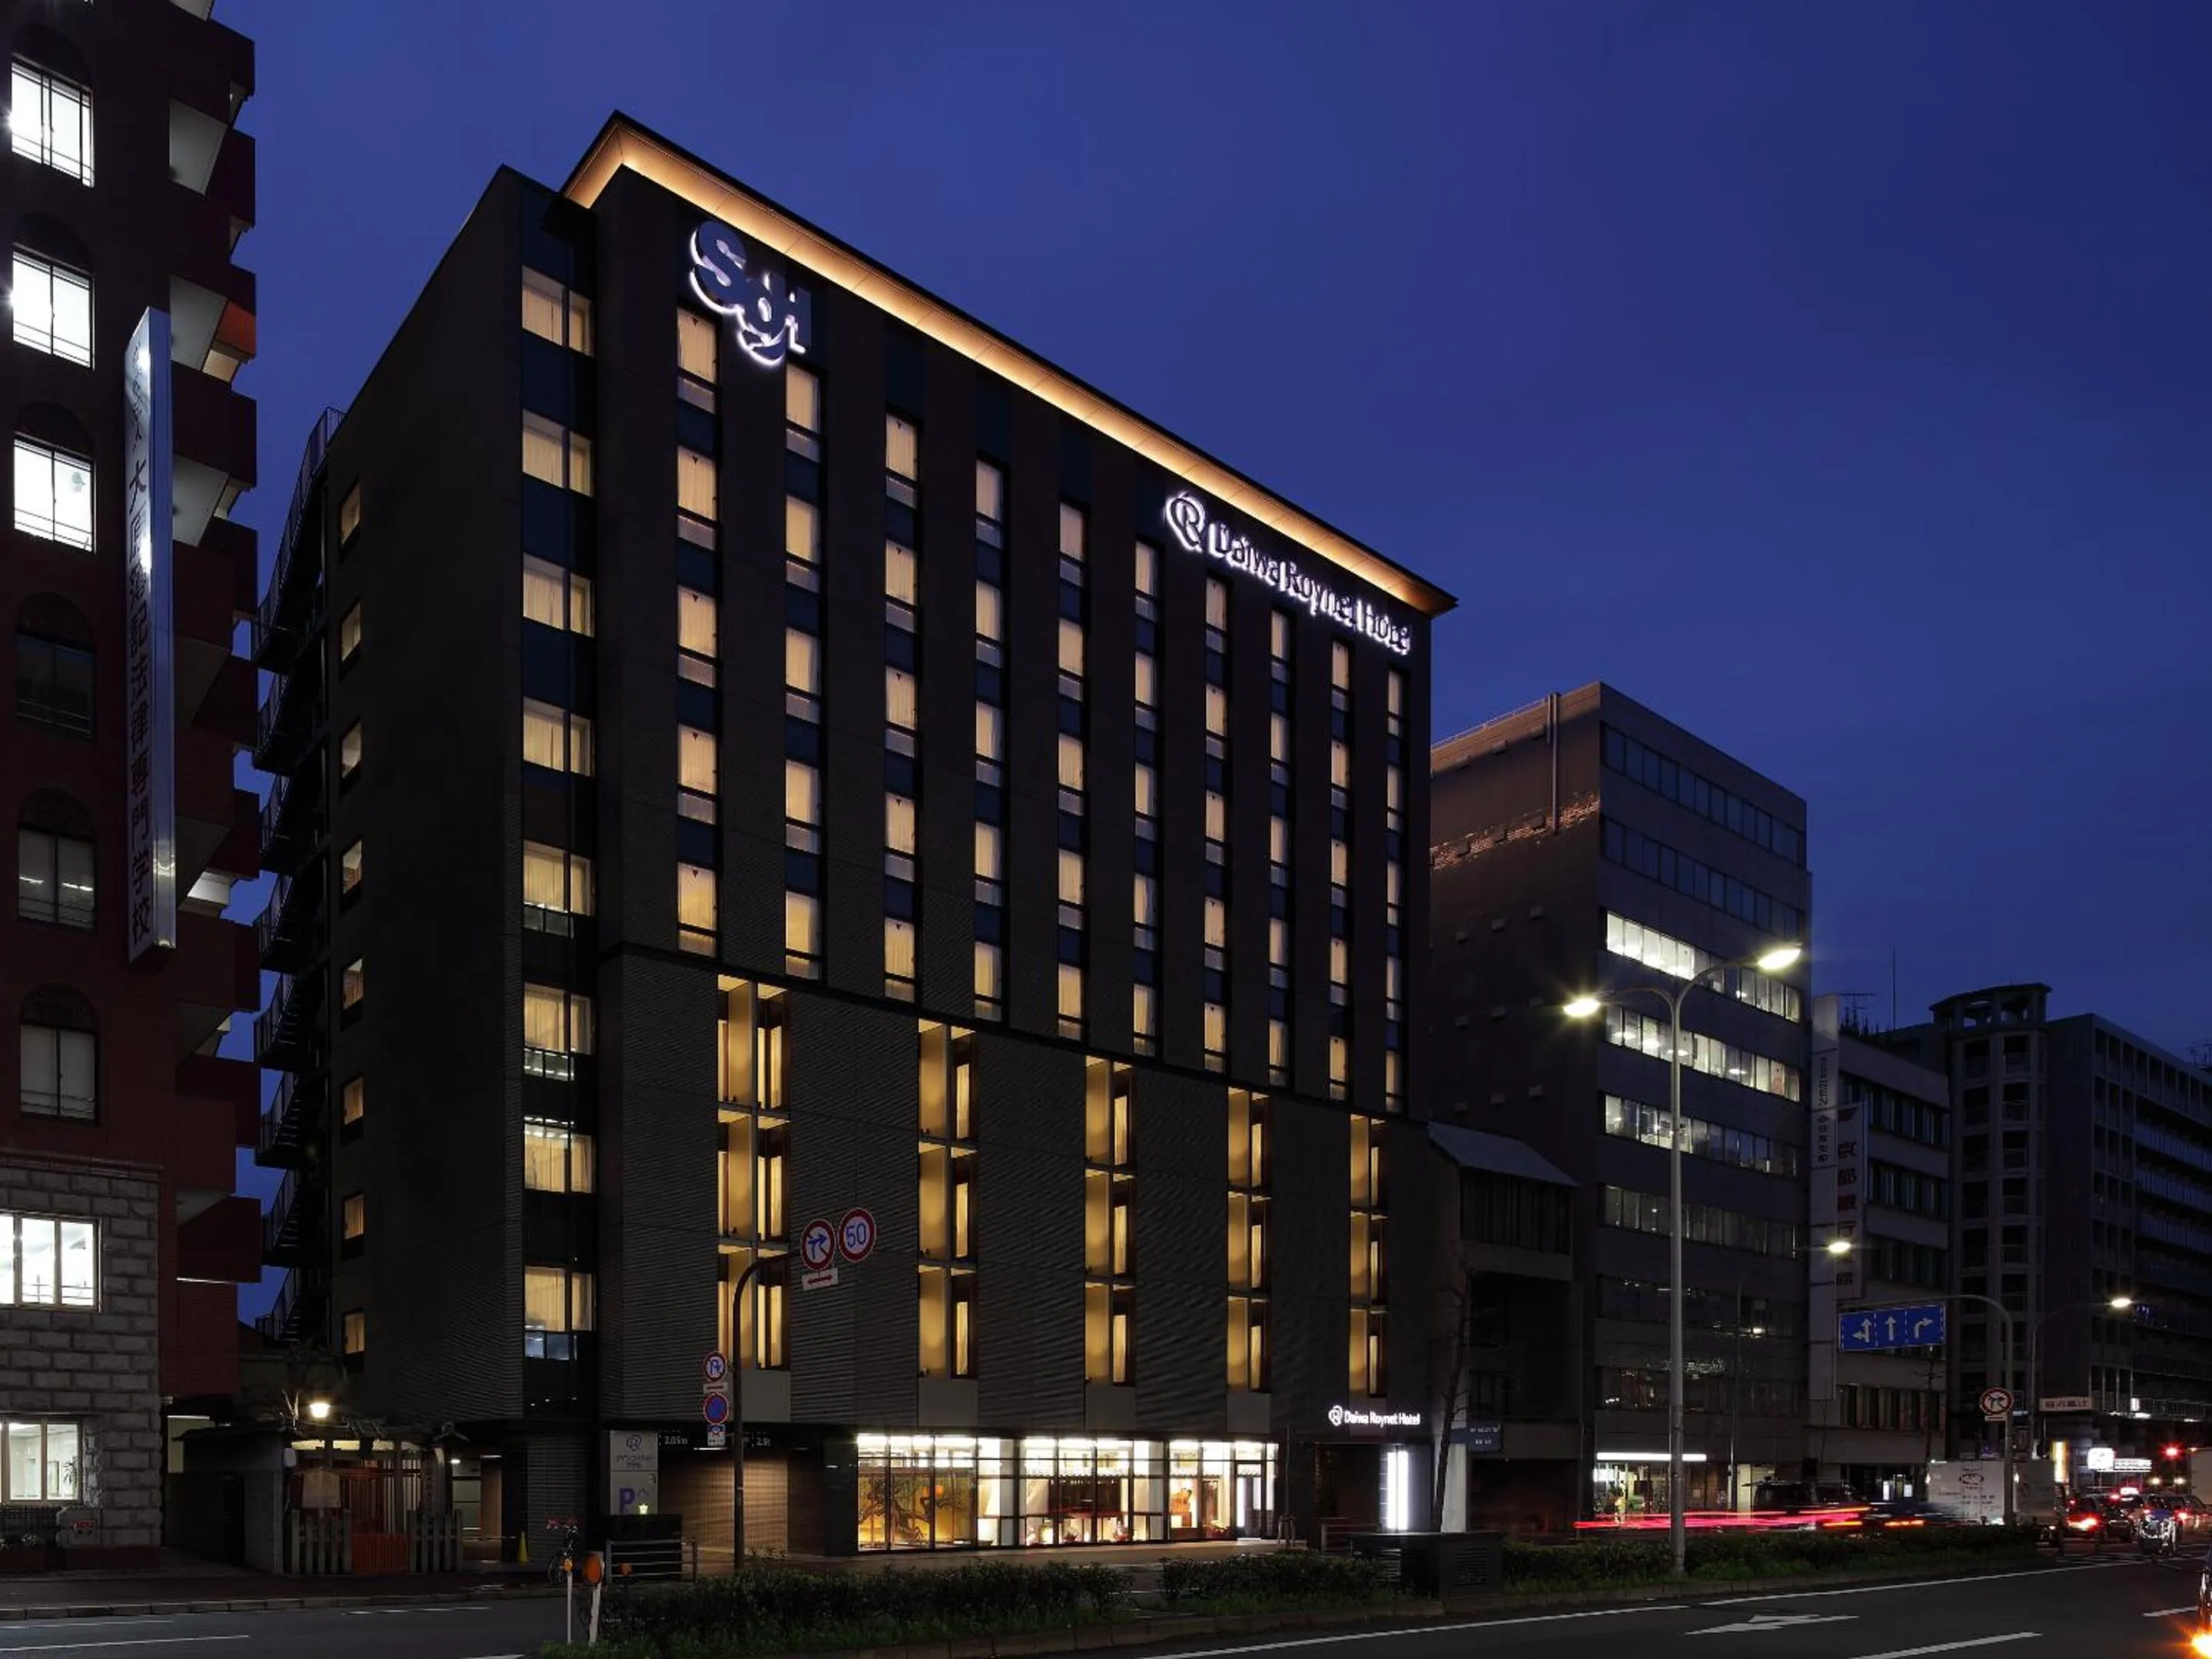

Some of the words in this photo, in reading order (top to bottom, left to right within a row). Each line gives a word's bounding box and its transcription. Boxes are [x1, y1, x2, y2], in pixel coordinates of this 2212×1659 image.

[846, 1223, 866, 1248] 50
[1344, 1411, 1370, 1424] Daiwa
[1370, 1411, 1399, 1428] Roynet
[1399, 1412, 1420, 1425] Hotel
